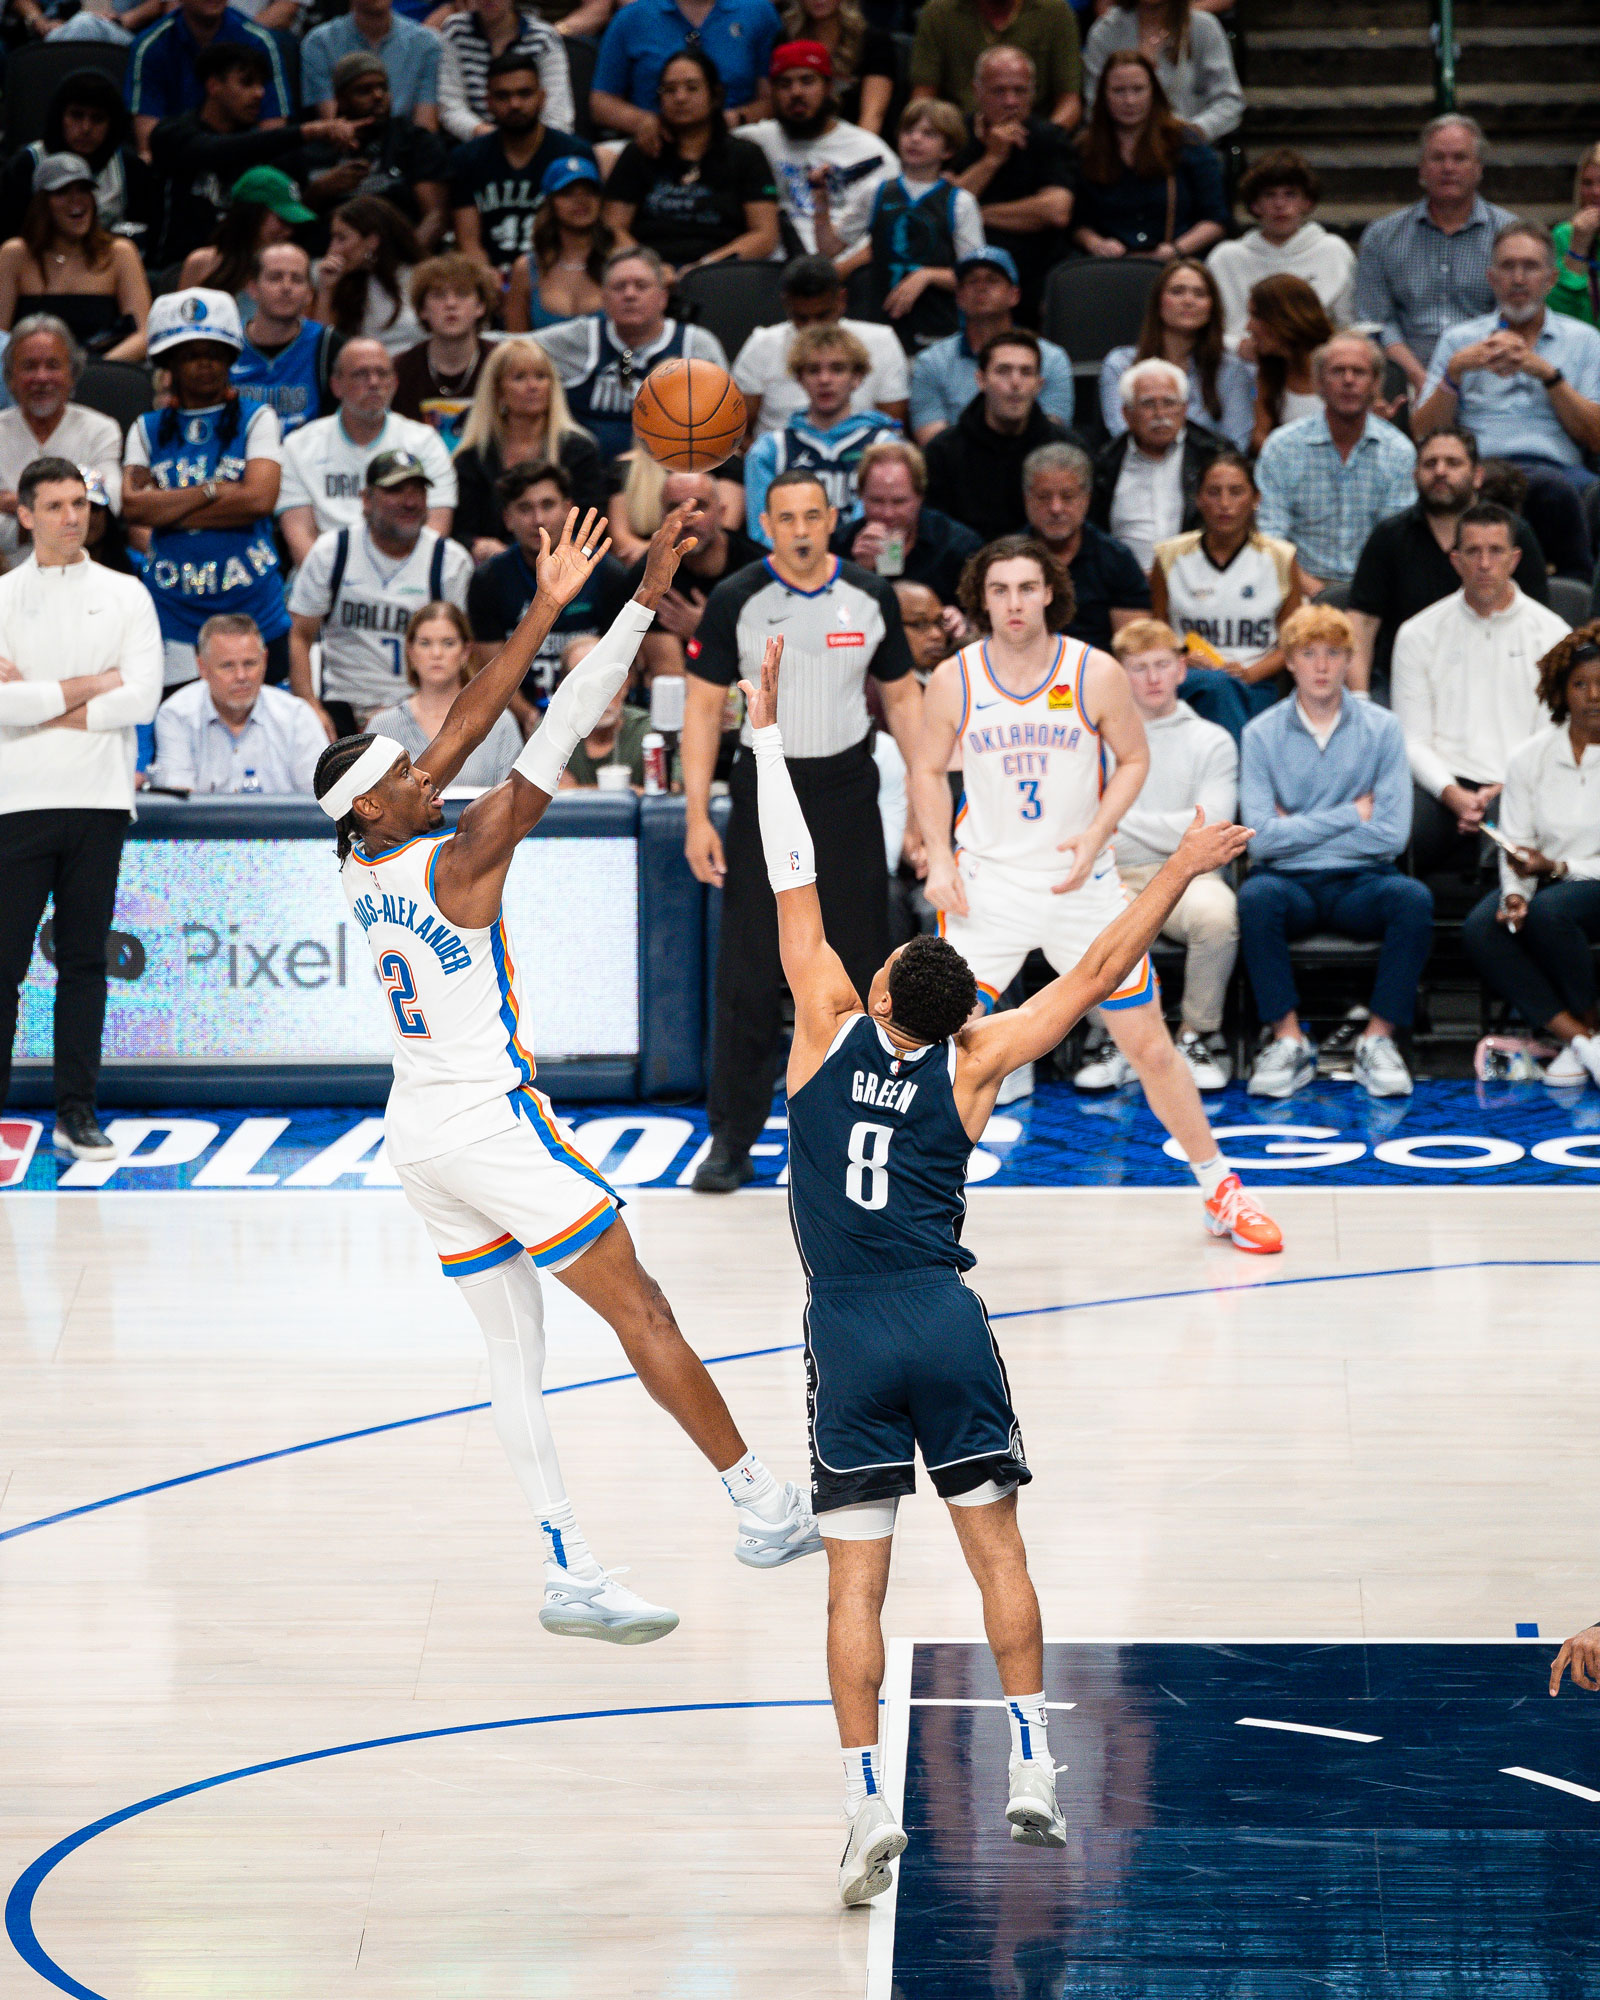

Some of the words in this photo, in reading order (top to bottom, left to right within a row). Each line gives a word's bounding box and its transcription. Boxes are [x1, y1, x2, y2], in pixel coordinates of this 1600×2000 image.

[143, 539, 278, 595] OMAN
[342, 601, 409, 634] DALLA
[968, 723, 1081, 755] OKLAHOMA
[1002, 752, 1048, 776] CITY
[1016, 779, 1045, 823] 3
[183, 921, 347, 989] Pixel
[379, 949, 431, 1039] 2
[852, 1070, 918, 1115] GREEN
[845, 1121, 894, 1210] 8
